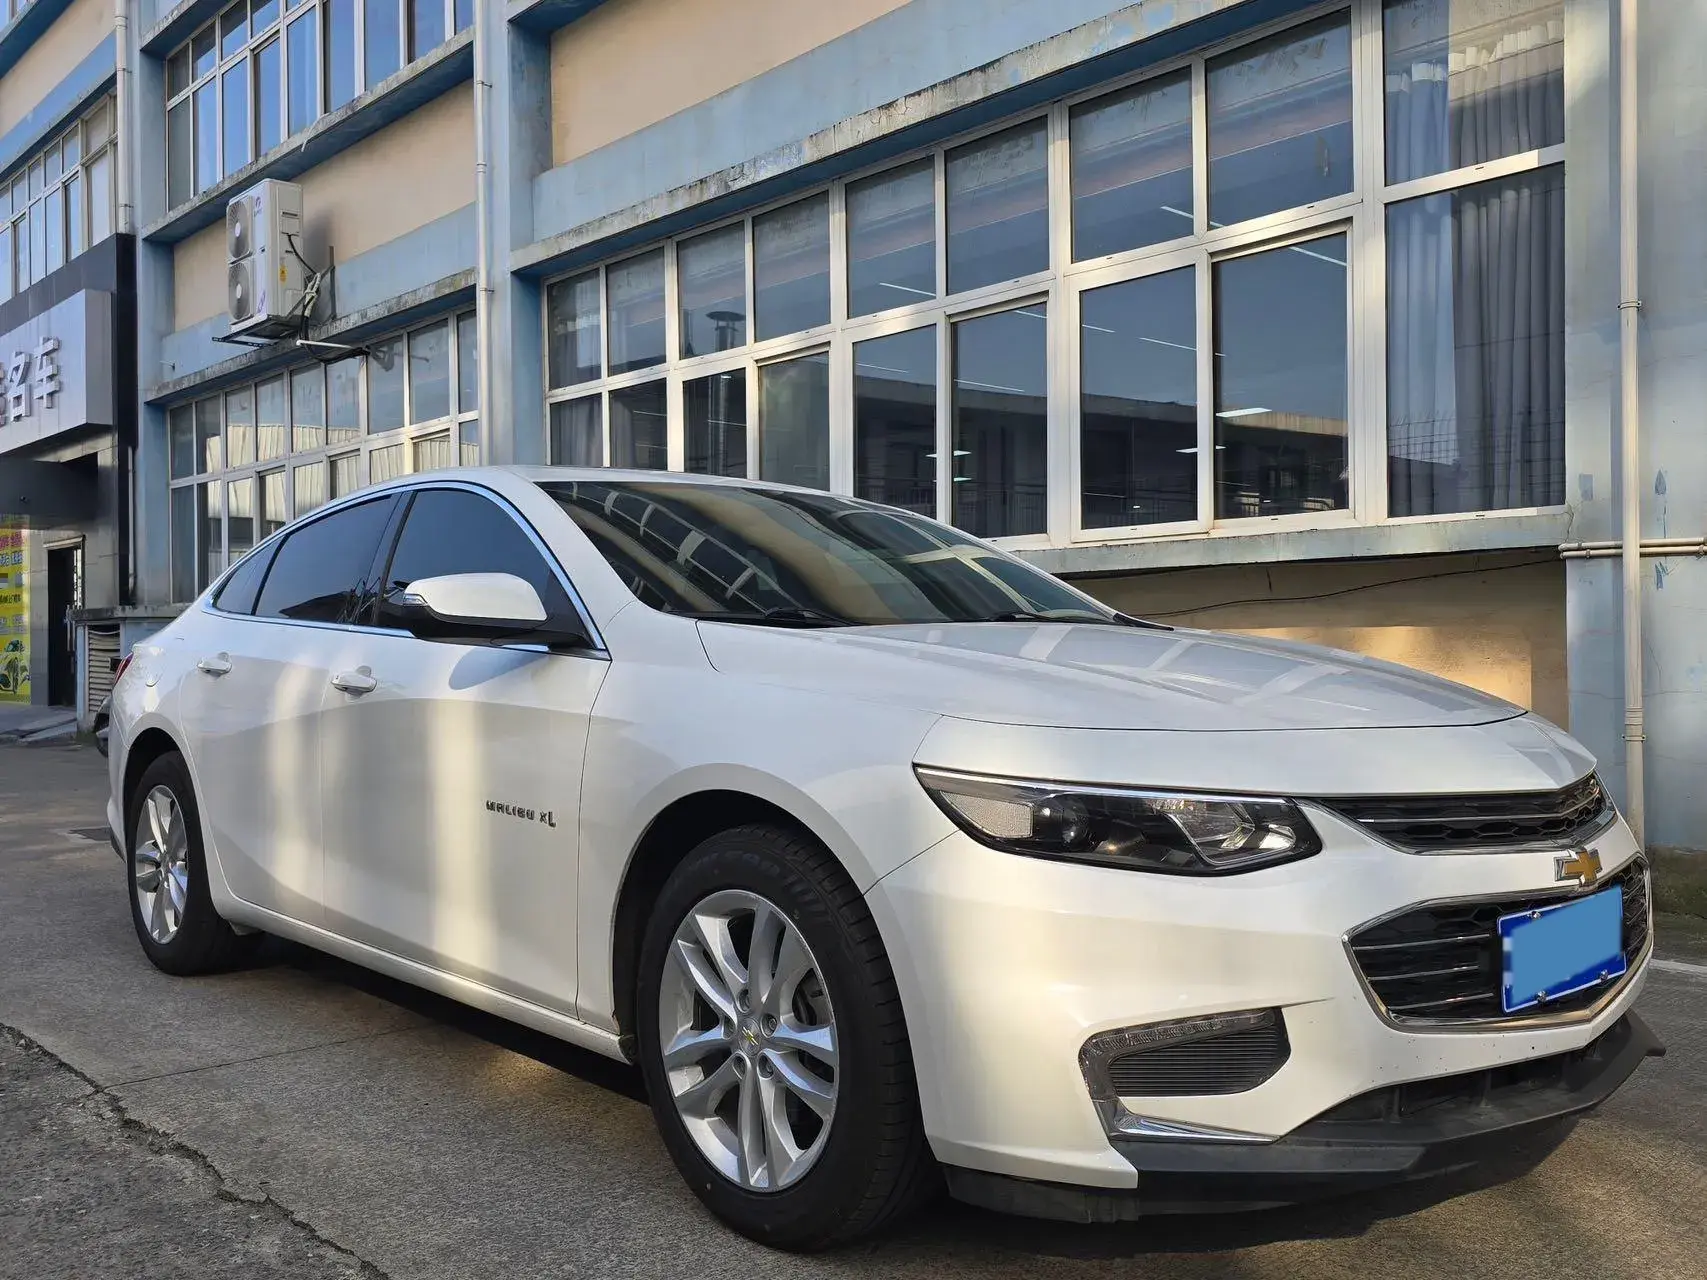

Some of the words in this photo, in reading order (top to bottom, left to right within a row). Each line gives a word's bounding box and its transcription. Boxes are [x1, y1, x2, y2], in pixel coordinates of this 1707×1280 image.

[0, 336, 60, 426] 名车
[486, 800, 535, 821] MALIBU
[539, 811, 557, 828] XL
